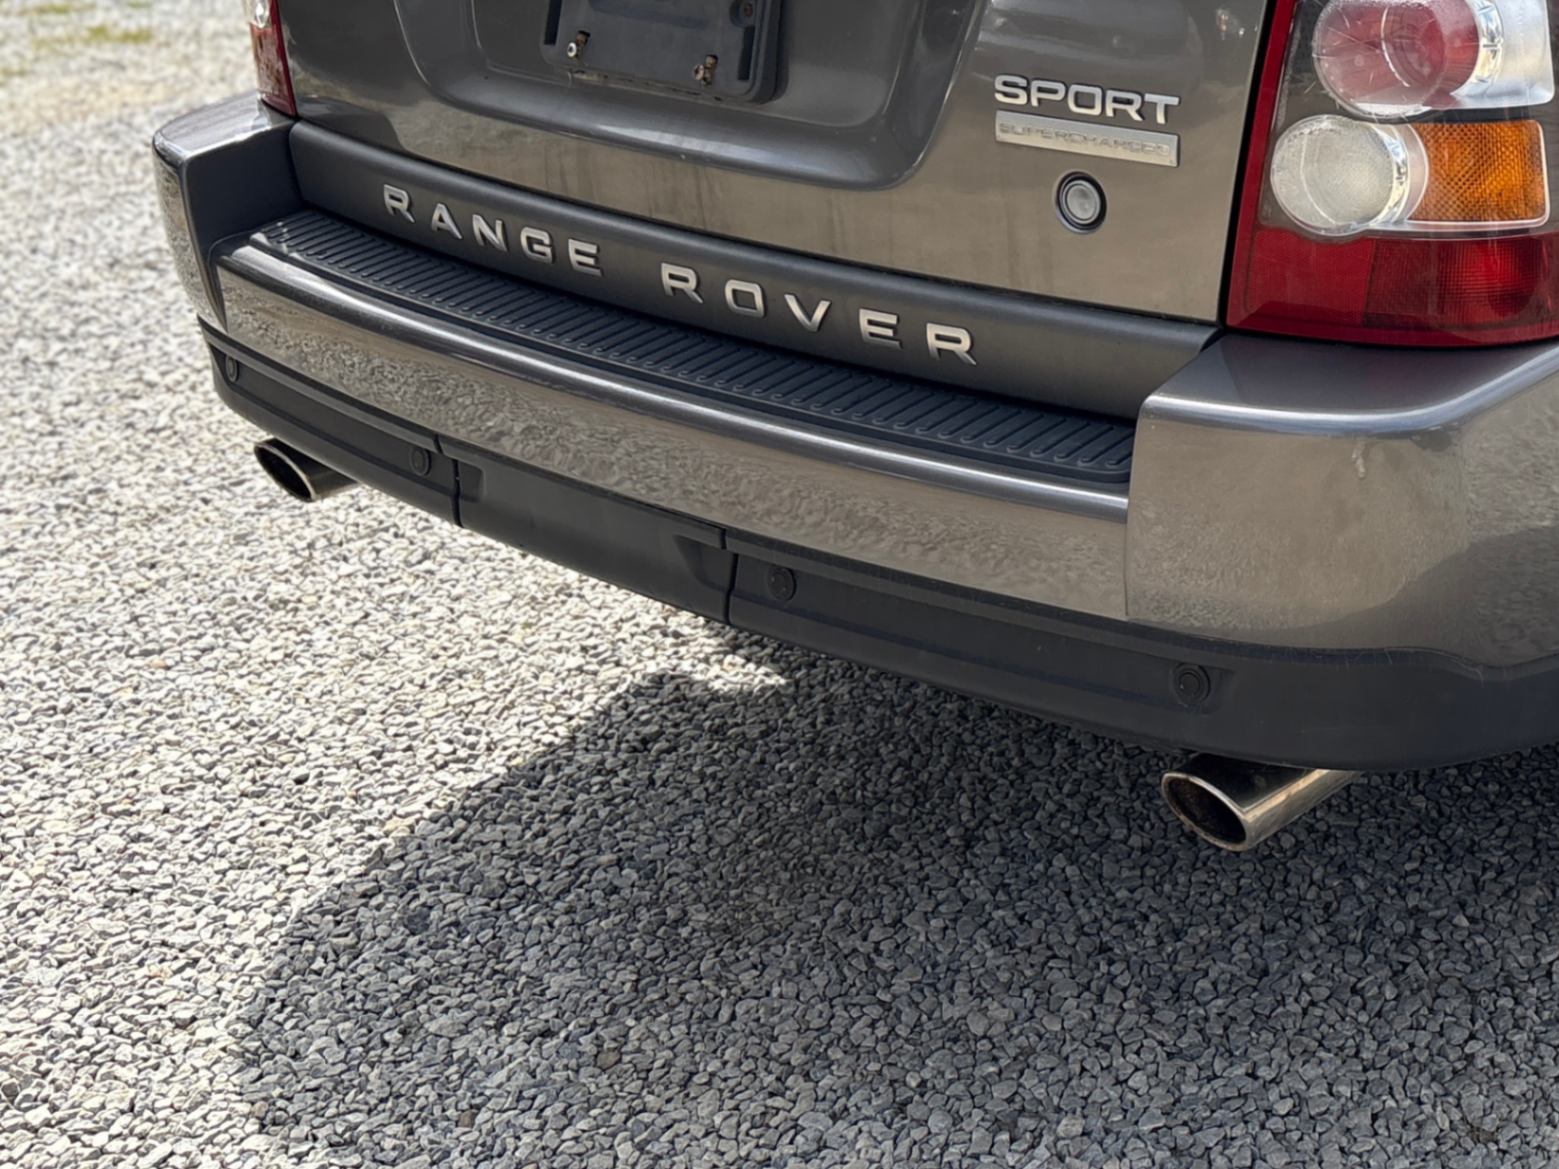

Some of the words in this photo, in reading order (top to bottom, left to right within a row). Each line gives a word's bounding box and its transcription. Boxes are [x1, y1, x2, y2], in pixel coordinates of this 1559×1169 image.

[994, 74, 1181, 125] SPORT
[382, 183, 602, 276] RANGE
[660, 261, 978, 365] ROVER
